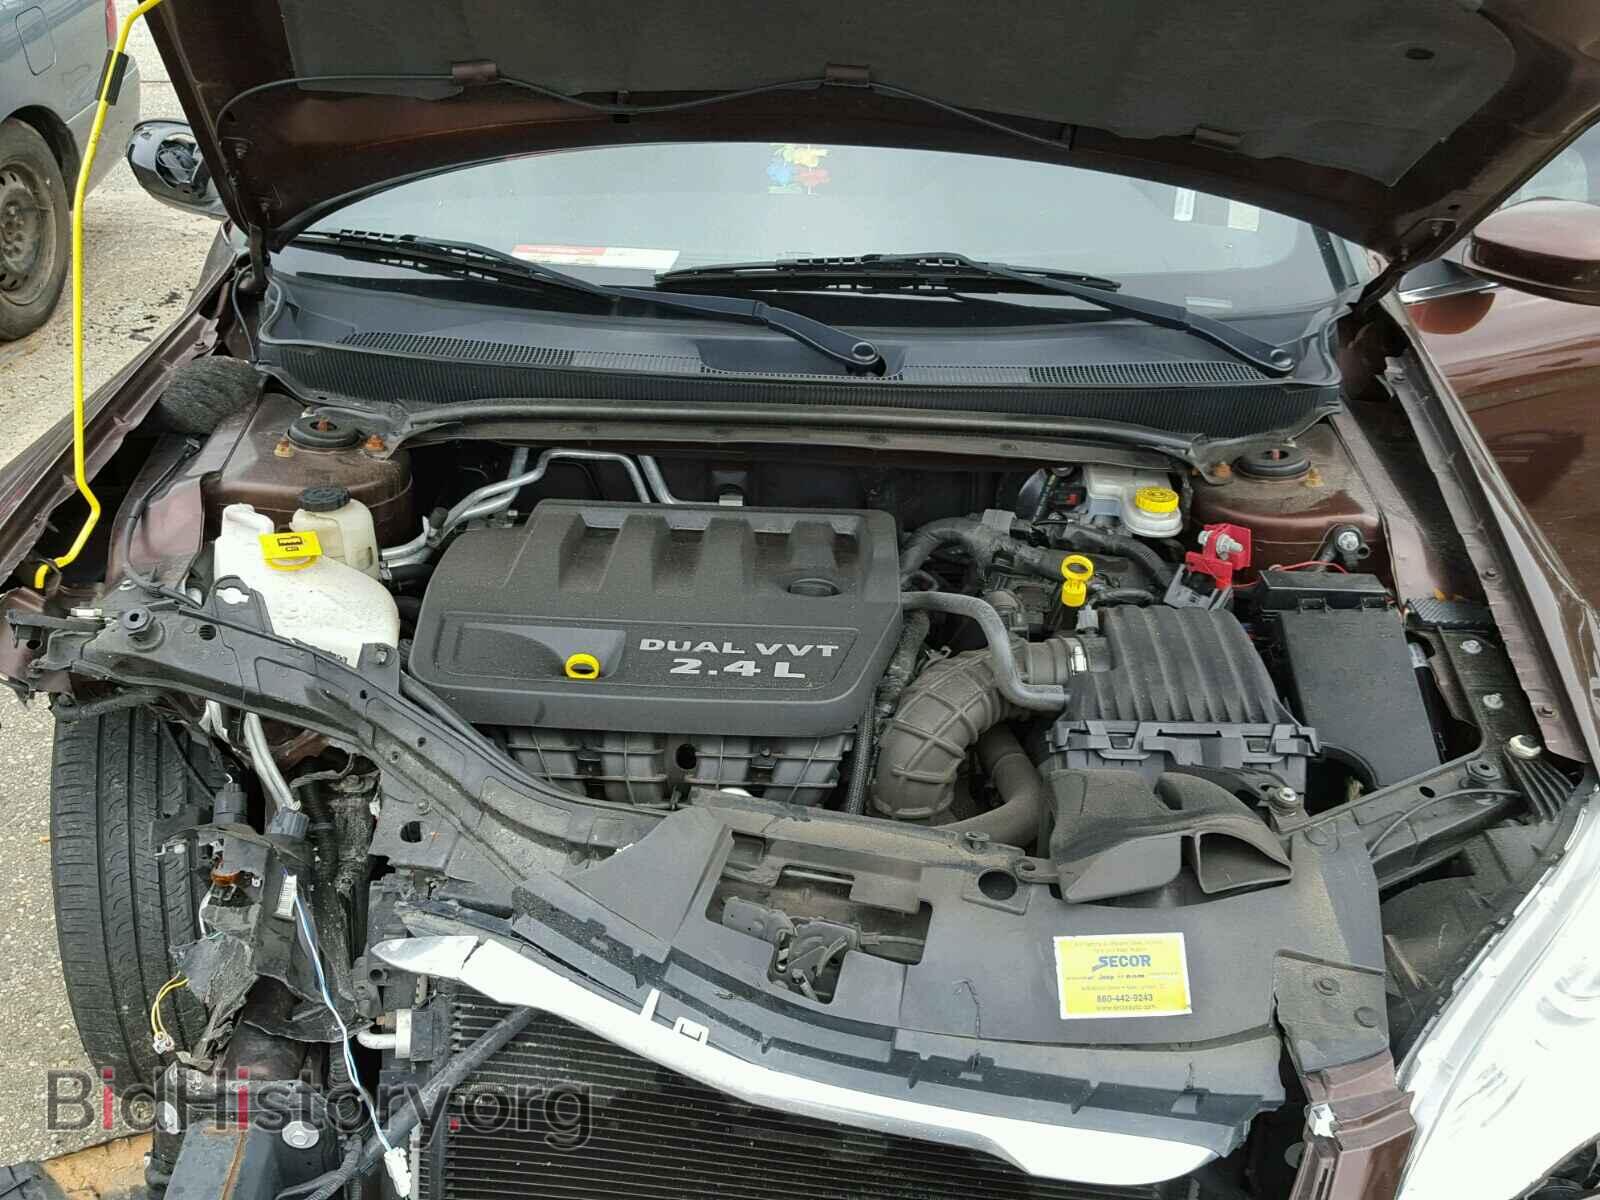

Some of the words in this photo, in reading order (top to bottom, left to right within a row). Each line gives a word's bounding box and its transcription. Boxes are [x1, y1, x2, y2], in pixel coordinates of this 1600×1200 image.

[640, 638, 745, 654] DUAL
[755, 643, 839, 657] VVT
[670, 658, 761, 677] 2.4
[773, 661, 806, 679] L
[1098, 954, 1151, 968] SECOR
